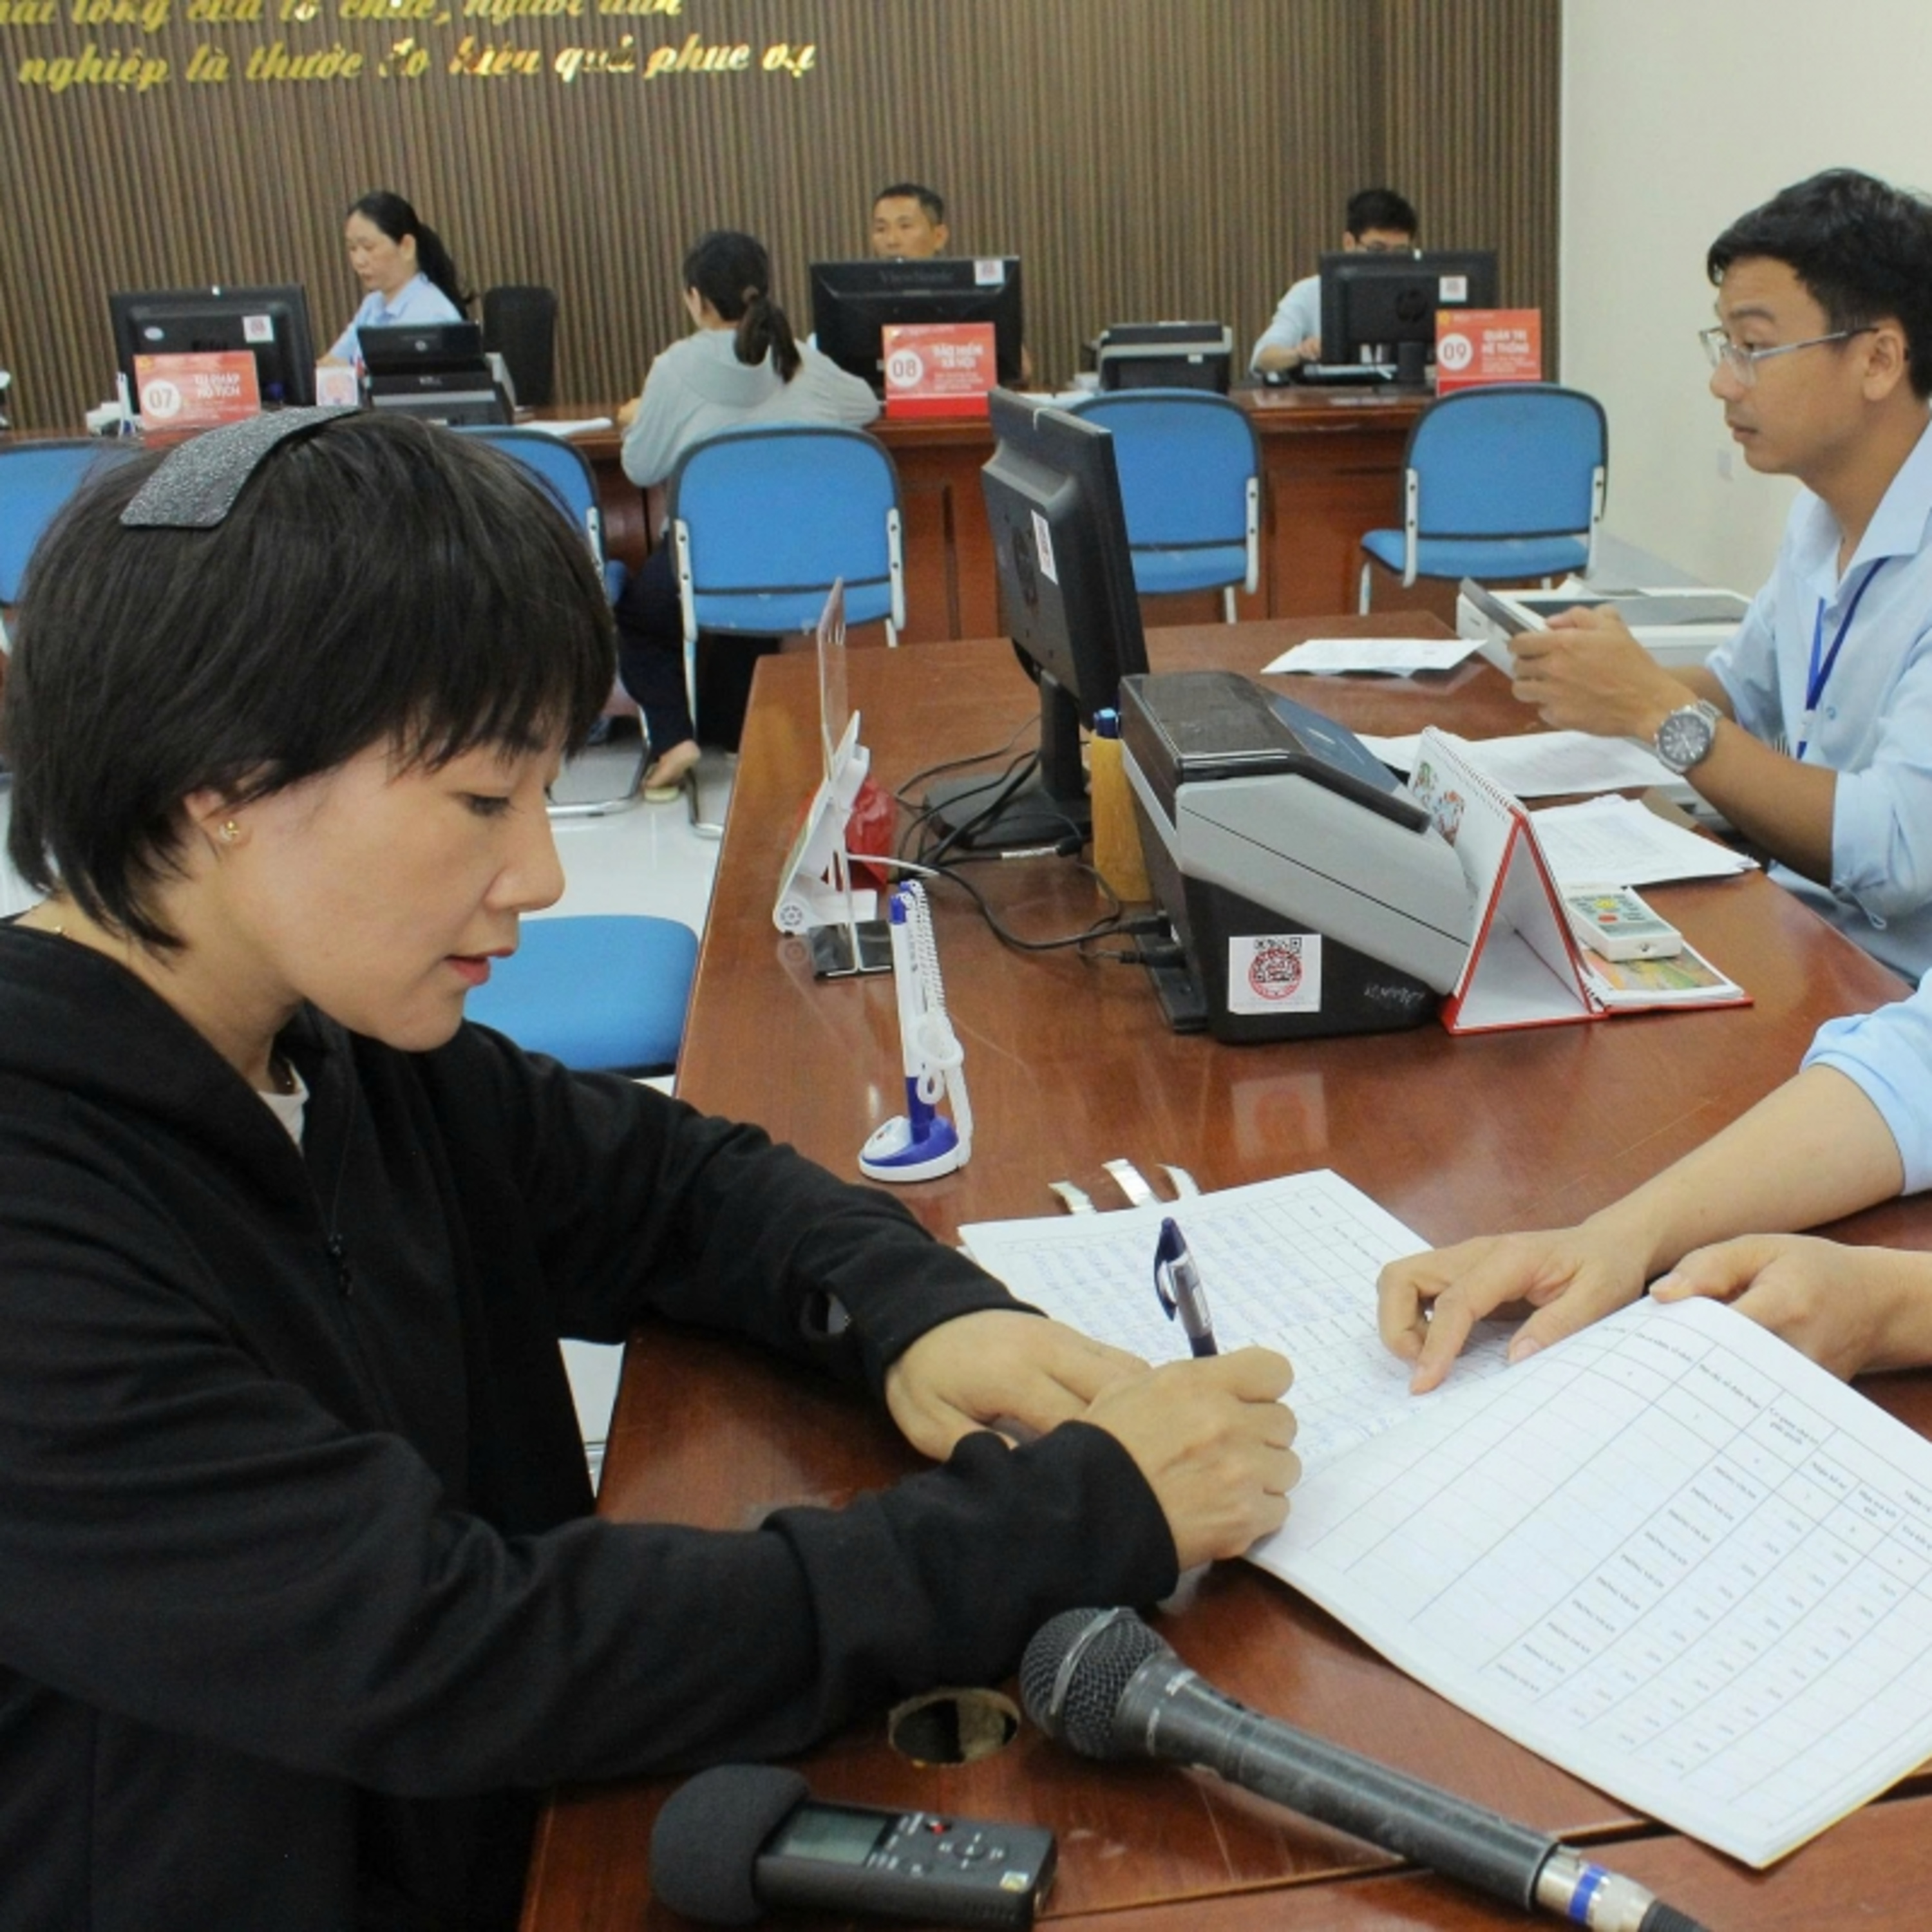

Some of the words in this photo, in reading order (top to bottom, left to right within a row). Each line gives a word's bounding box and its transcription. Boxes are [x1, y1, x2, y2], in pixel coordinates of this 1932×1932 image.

[1443, 343, 1467, 361] 09
[893, 359, 916, 377] 08
[148, 388, 173, 409] 07
